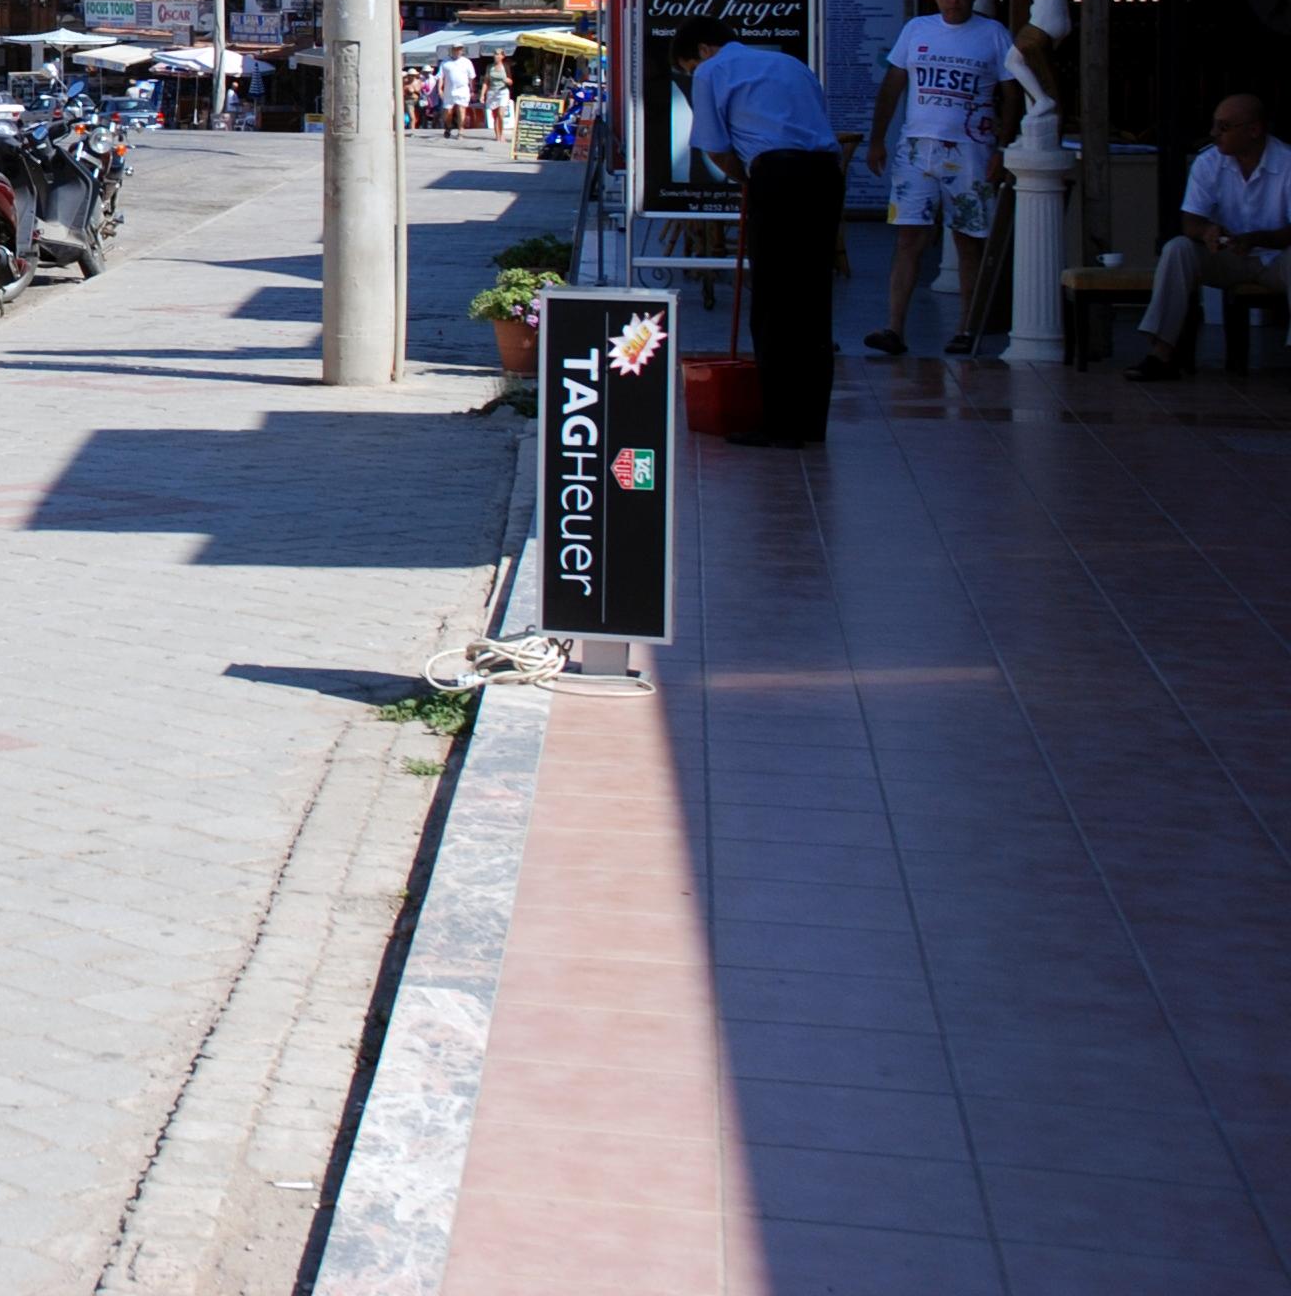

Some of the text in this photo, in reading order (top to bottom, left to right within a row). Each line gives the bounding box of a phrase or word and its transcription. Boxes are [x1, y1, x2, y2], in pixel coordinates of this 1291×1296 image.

[86, 0, 109, 15] FOCUS
[110, 1, 135, 16] TOURS
[741, 28, 772, 38] Beauty
[774, 28, 800, 37] Salon
[917, 67, 980, 94] DIESEL
